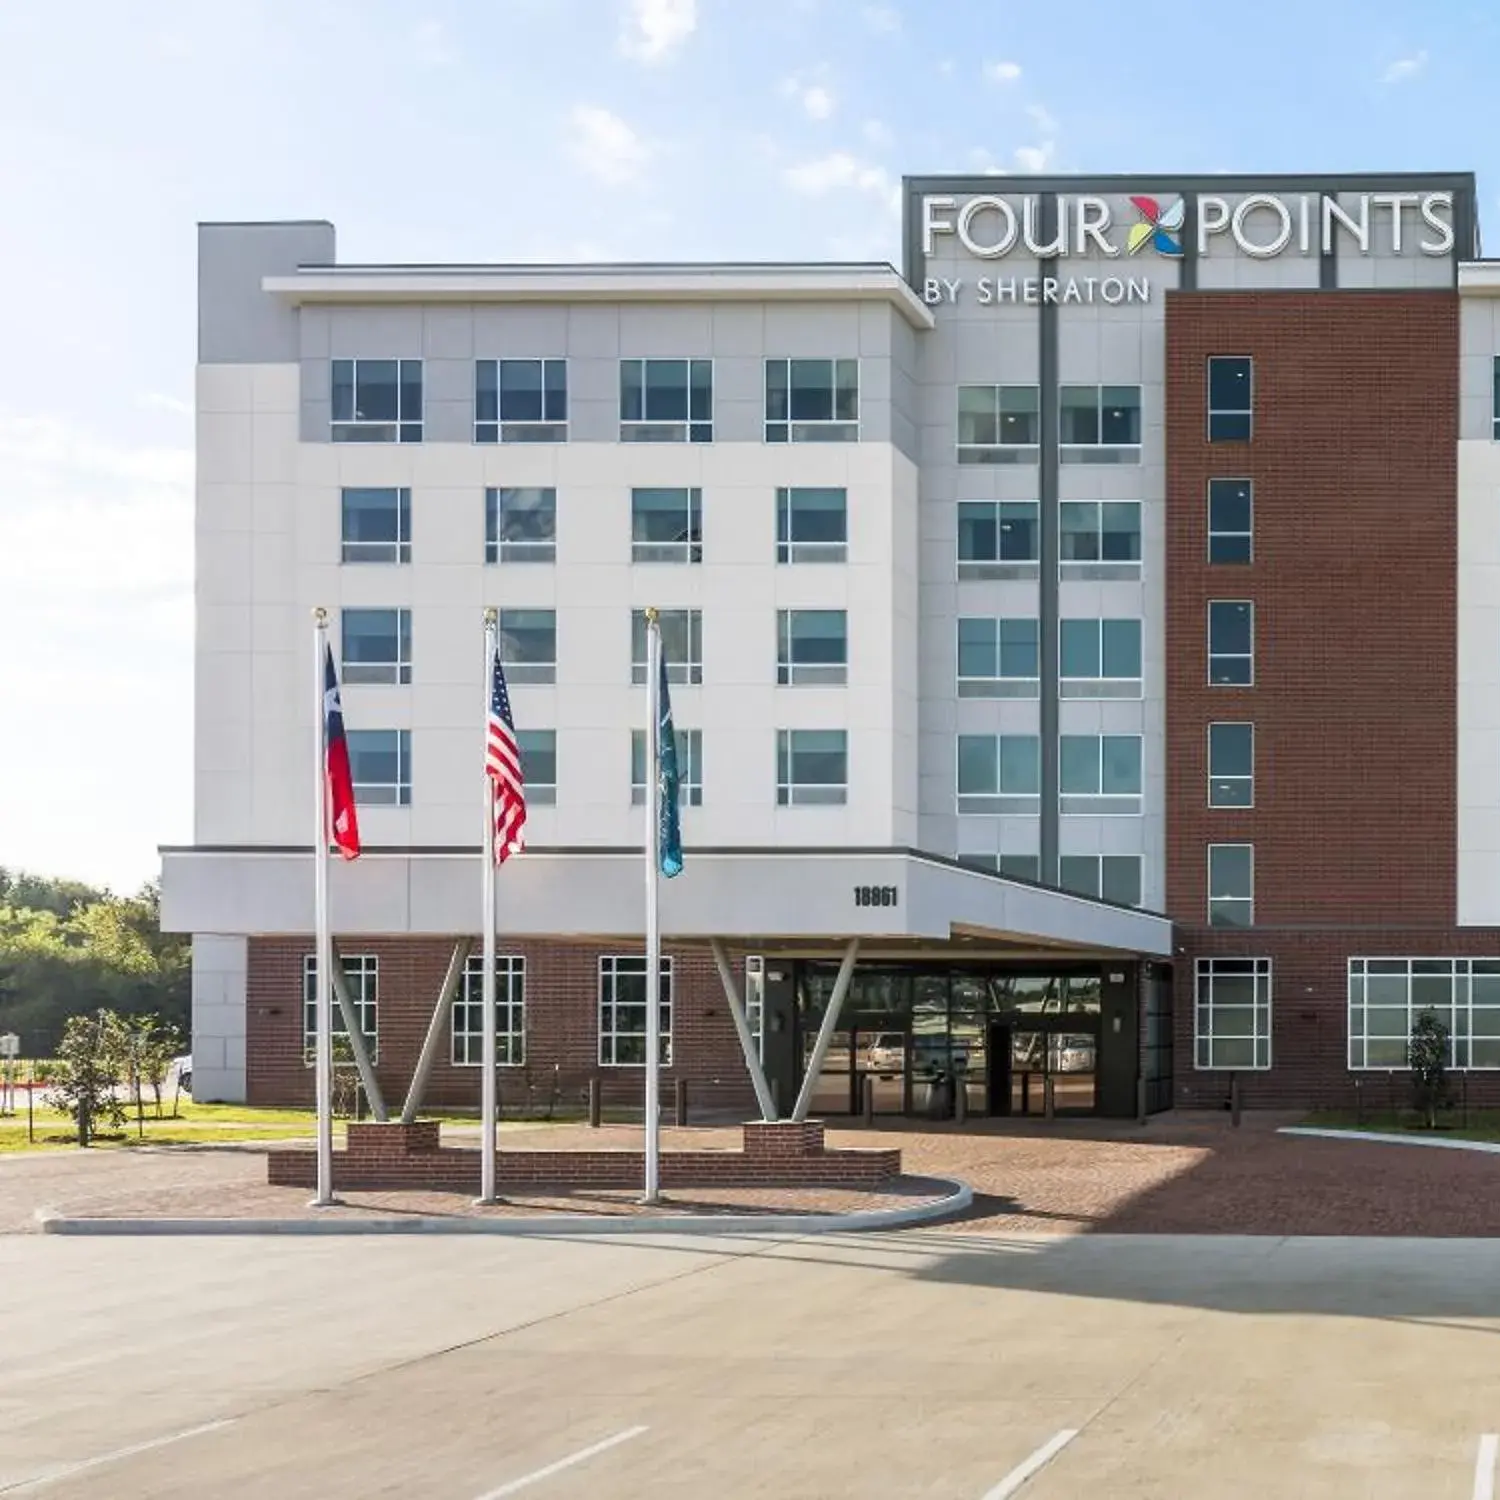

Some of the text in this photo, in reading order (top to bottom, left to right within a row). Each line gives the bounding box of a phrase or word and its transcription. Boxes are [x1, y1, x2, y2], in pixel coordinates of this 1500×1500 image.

[922, 193, 1456, 259] FOUR POINTS
[924, 274, 1149, 304] BY SHERATON
